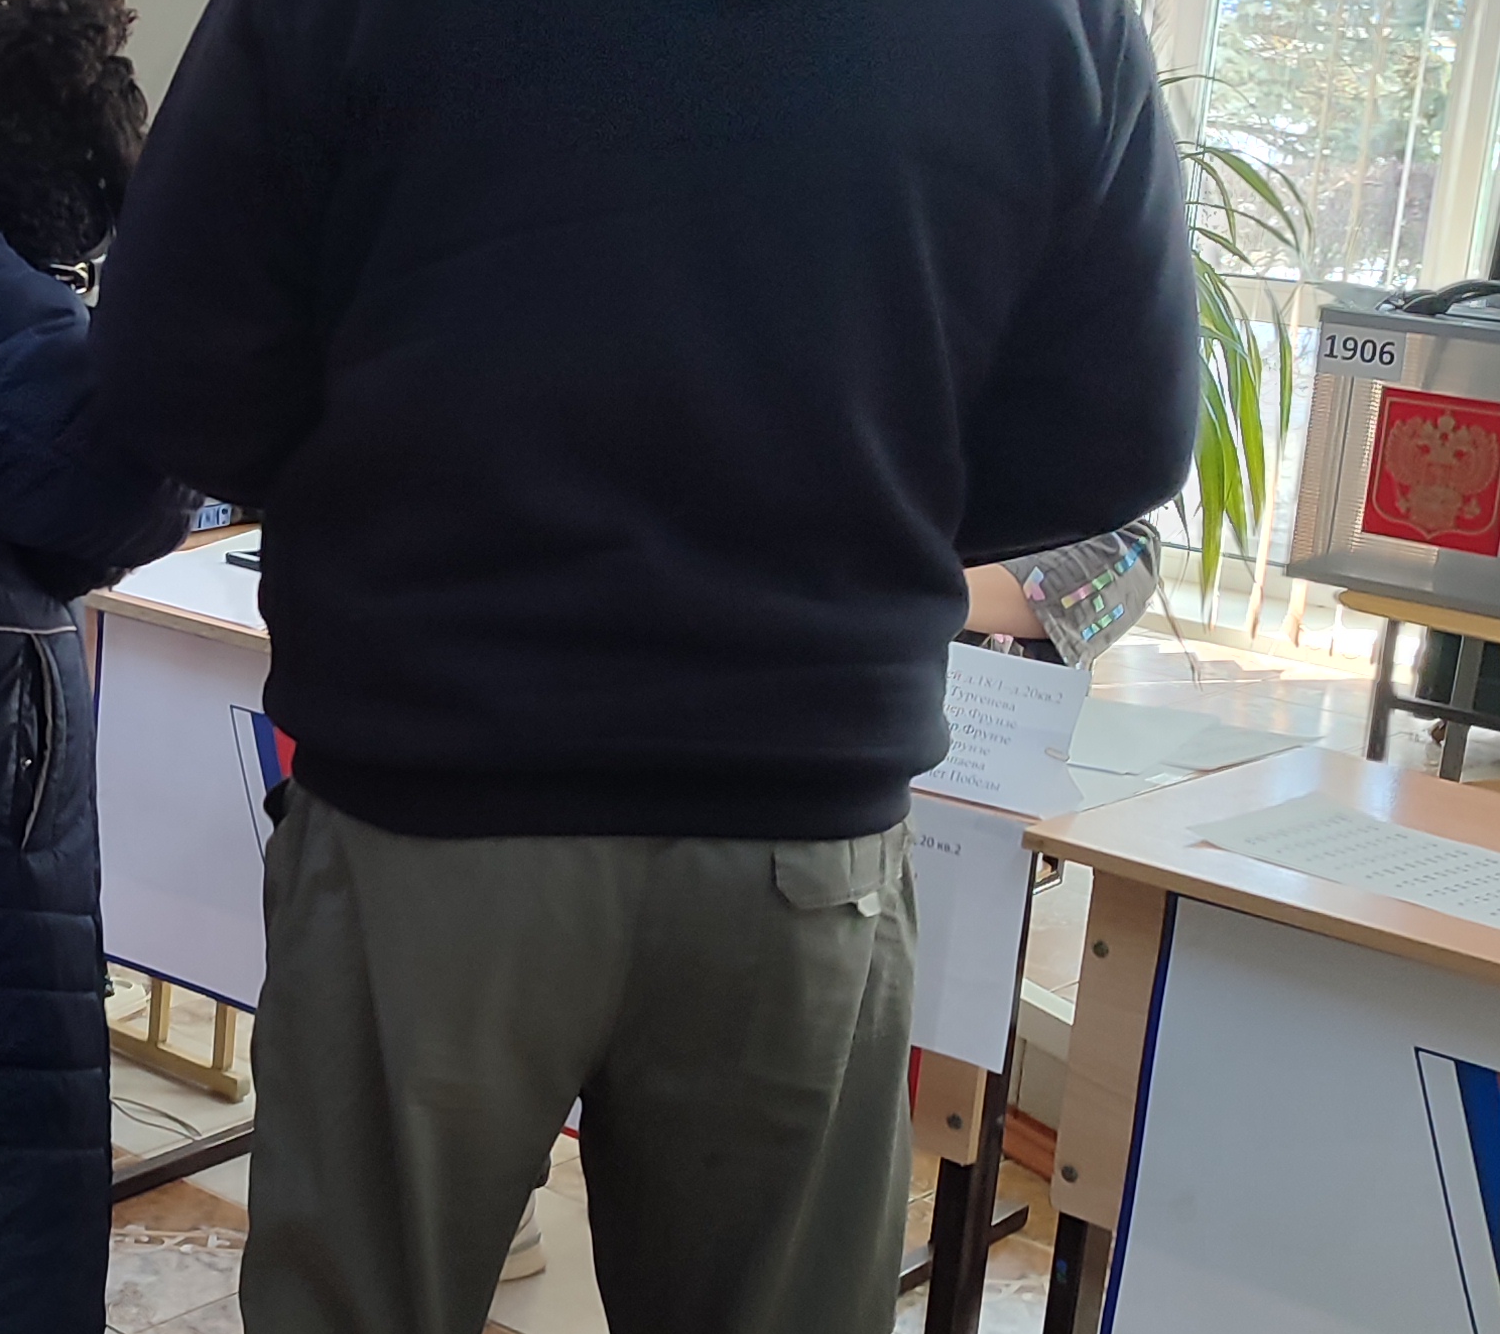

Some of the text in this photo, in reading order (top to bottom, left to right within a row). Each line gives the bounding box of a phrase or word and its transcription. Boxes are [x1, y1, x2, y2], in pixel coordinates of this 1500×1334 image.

[1323, 334, 1395, 366] 1906
[950, 685, 1016, 712] Тургенева
[950, 738, 991, 757] рунзе
[949, 769, 1001, 792] Победы
